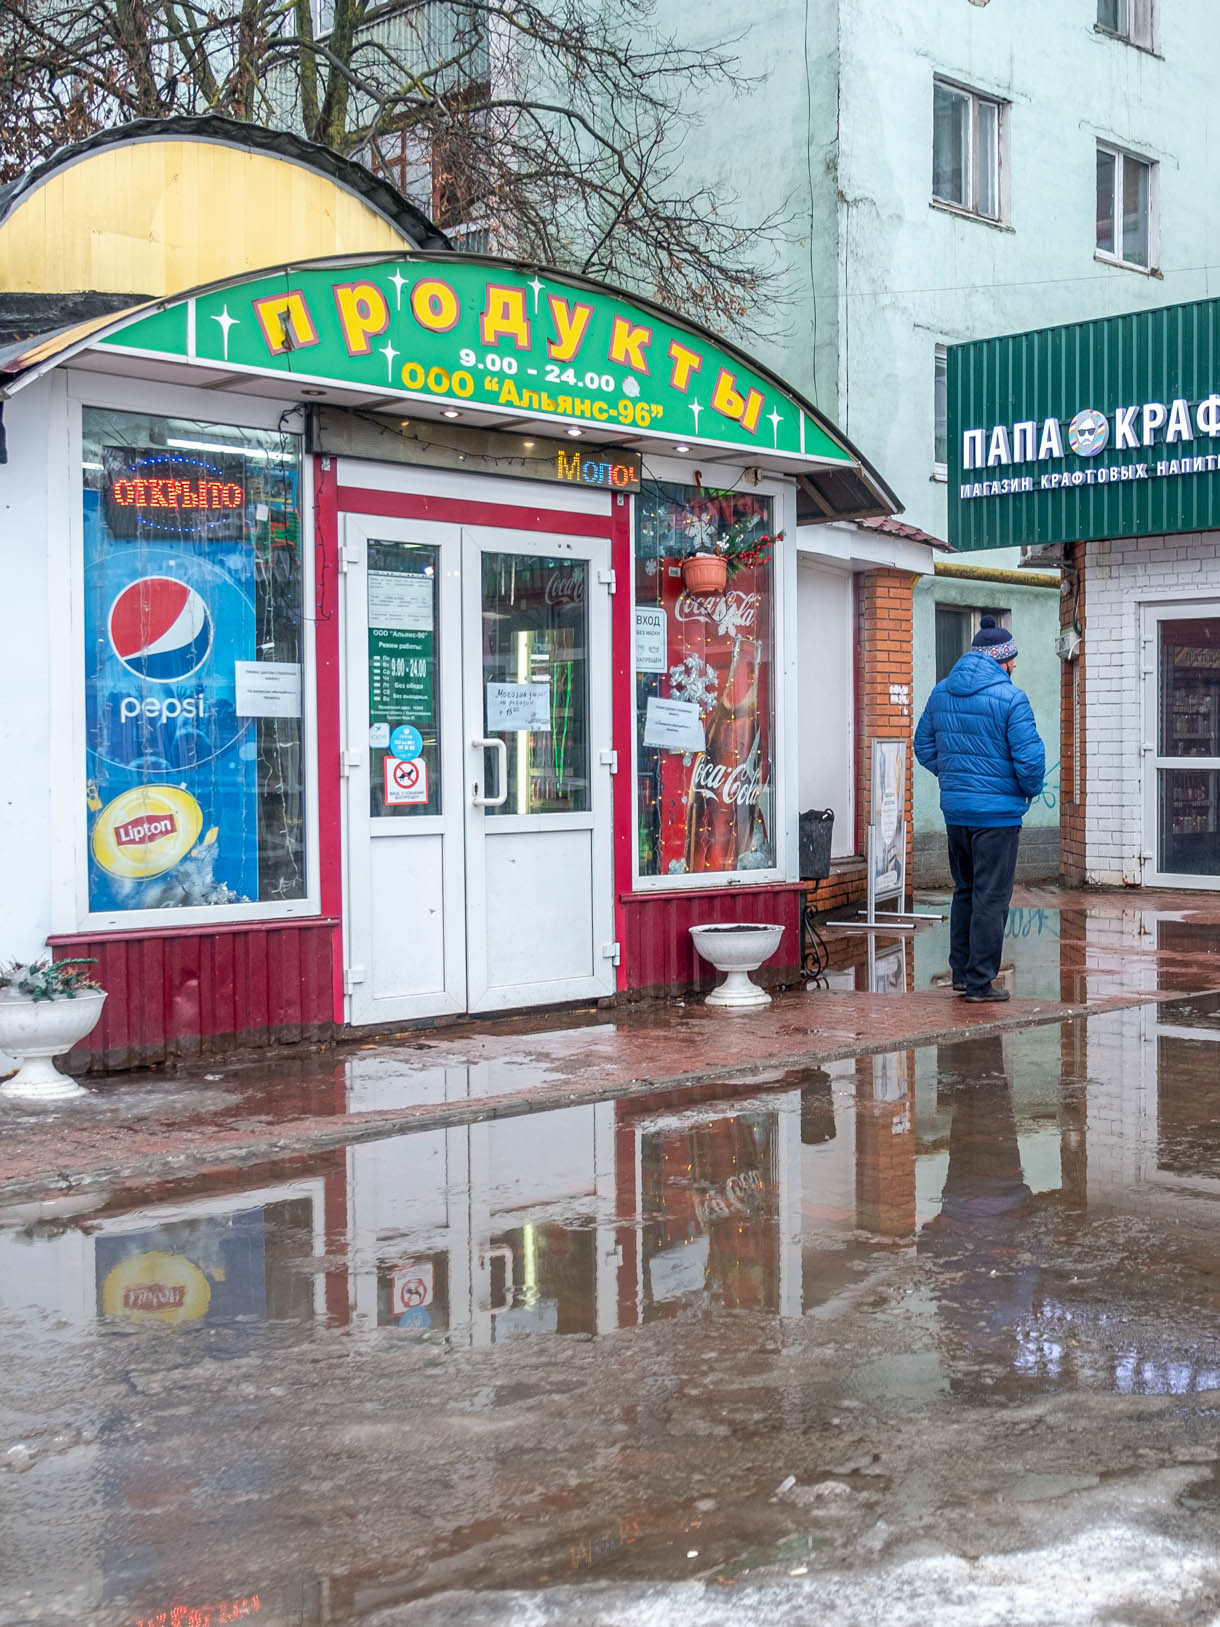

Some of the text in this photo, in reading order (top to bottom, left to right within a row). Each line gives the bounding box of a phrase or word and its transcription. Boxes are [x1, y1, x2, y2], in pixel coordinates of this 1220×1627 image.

[401, 361, 475, 399] ООО
[459, 348, 518, 375] 9.00
[545, 363, 615, 393] 24.00
[963, 417, 1064, 470] ПАПА
[114, 479, 242, 508] ОТКРЫТО
[960, 476, 1033, 499] МАГАЗИН
[1041, 463, 1147, 490] КРАФТОВЫХ
[636, 615, 661, 627] ВХОД
[120, 694, 204, 723] pepsi
[119, 818, 172, 842] Lipton
